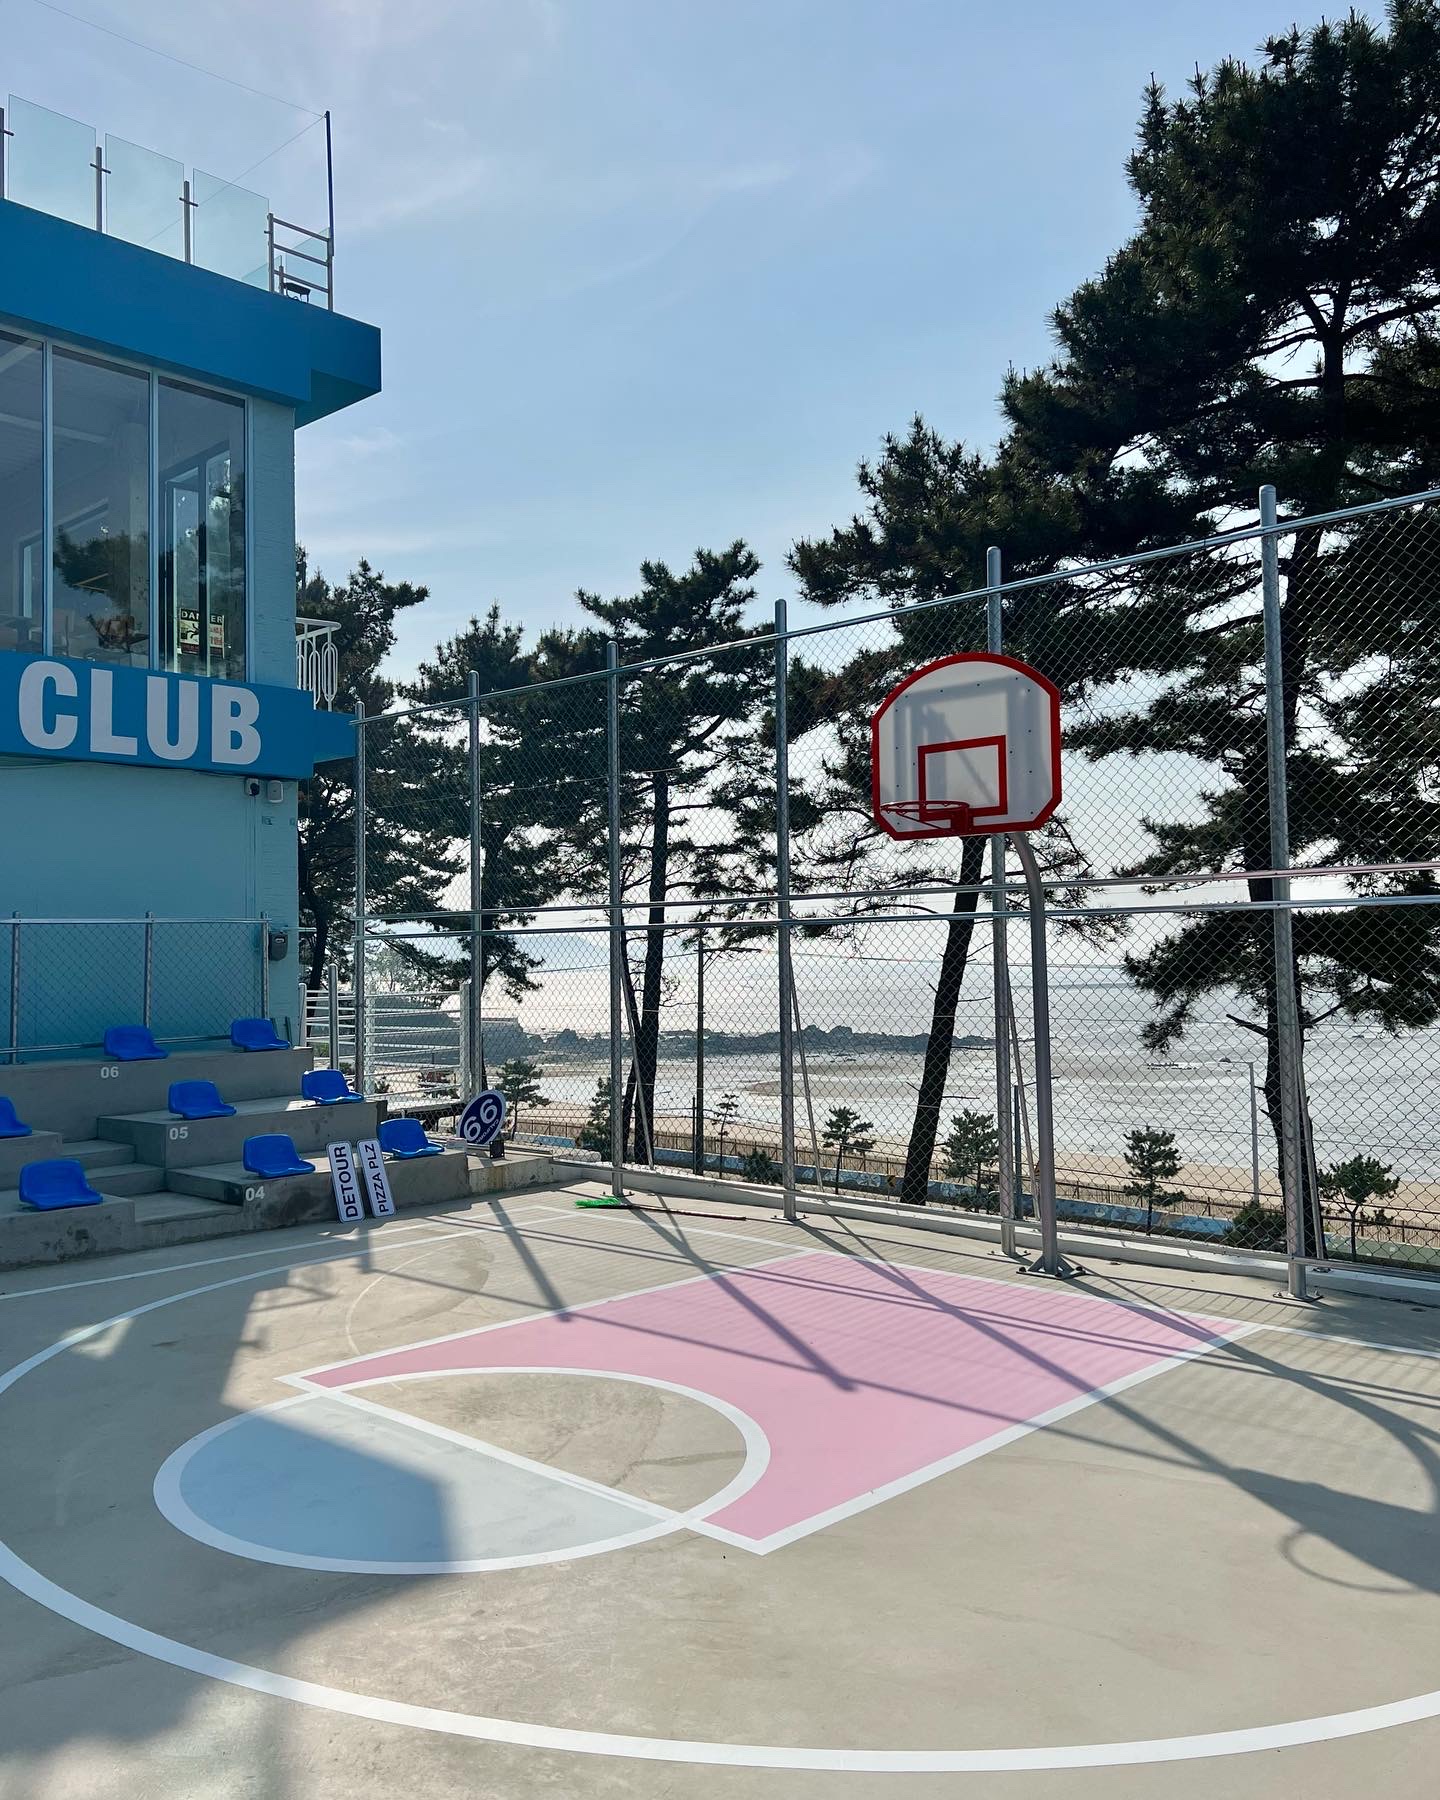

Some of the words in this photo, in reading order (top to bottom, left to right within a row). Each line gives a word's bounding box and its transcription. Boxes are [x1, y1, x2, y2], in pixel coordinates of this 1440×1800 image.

[181, 610, 223, 624] DAER
[18, 660, 262, 765] CLUB
[100, 1066, 119, 1079] 06
[169, 1126, 189, 1140] 05
[364, 1143, 379, 1170] PLZ
[334, 1146, 358, 1218] DETOUR
[372, 1172, 389, 1213] PIZZA
[245, 1185, 265, 1201] 04
